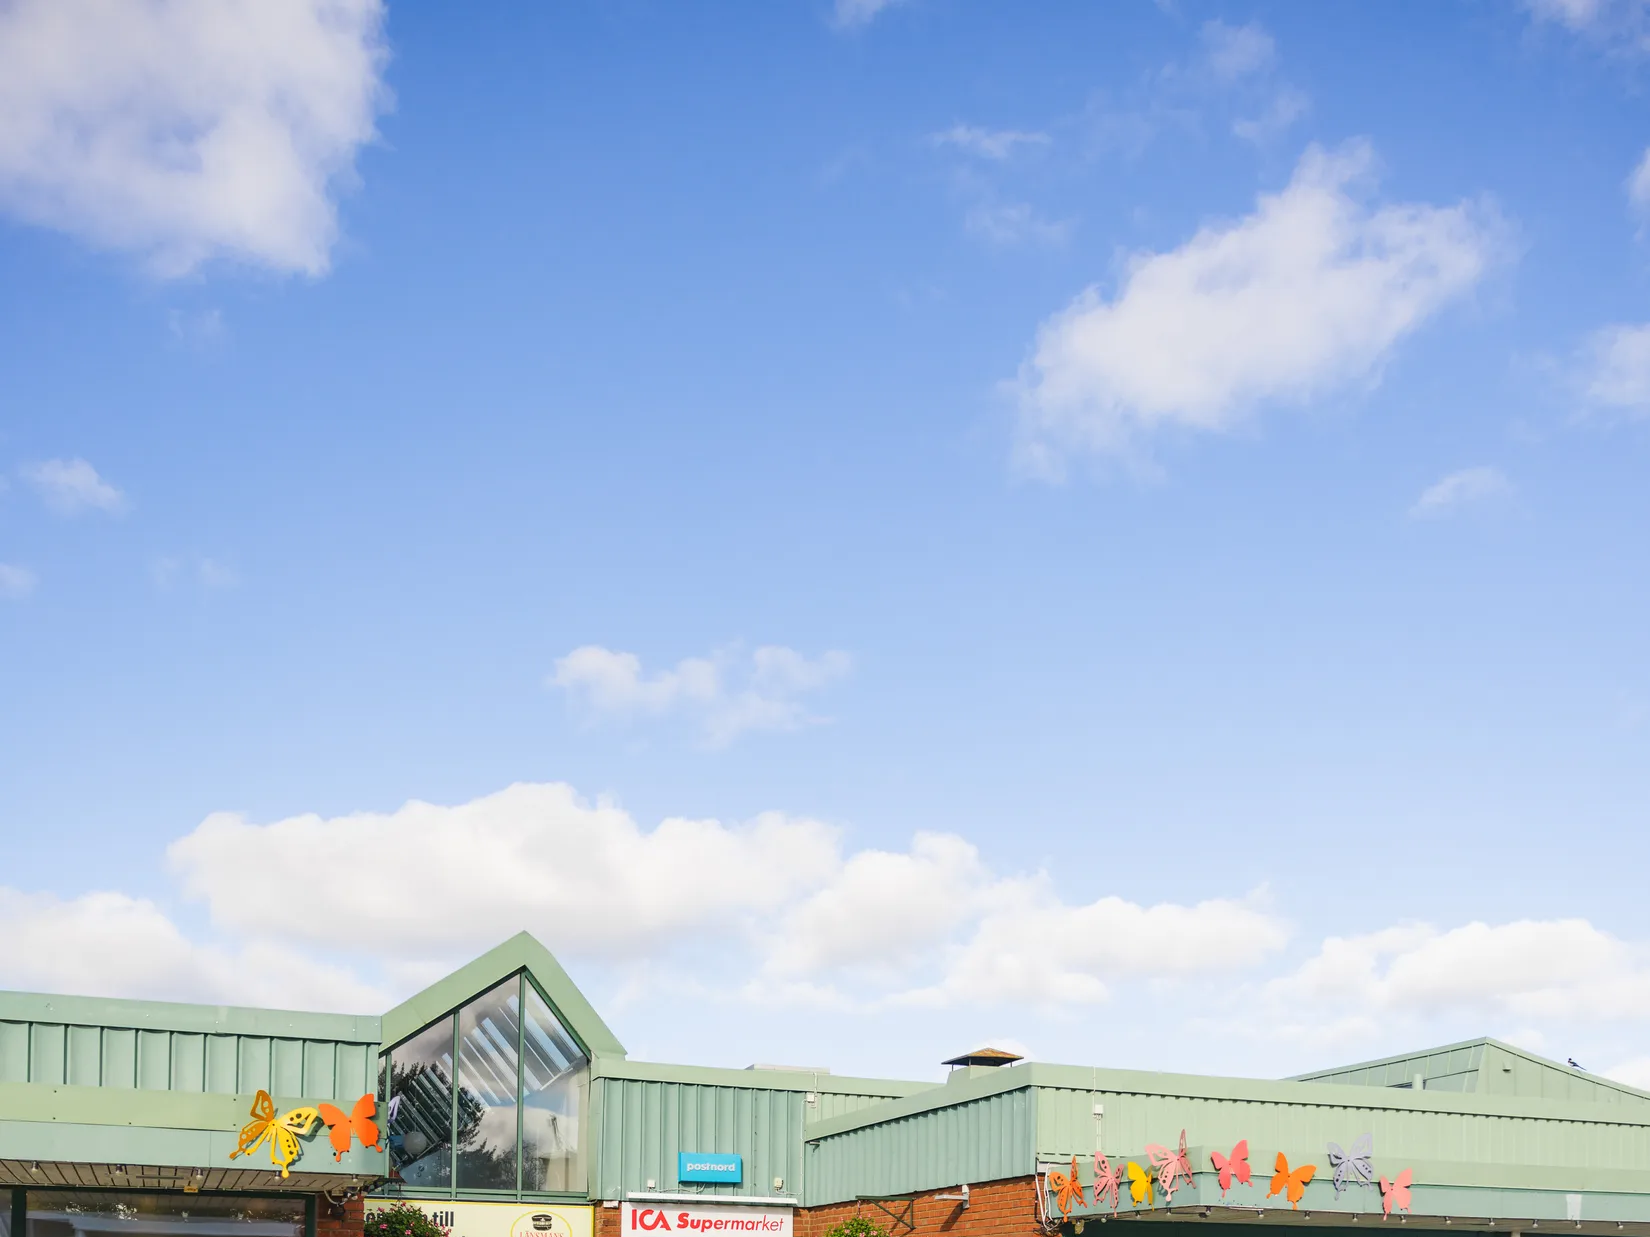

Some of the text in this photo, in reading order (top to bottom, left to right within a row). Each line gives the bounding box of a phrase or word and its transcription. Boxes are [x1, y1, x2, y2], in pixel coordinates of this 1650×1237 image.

[686, 1162, 736, 1173] postnord
[432, 1211, 454, 1227] till
[631, 1209, 784, 1233] ICA Supermarket
